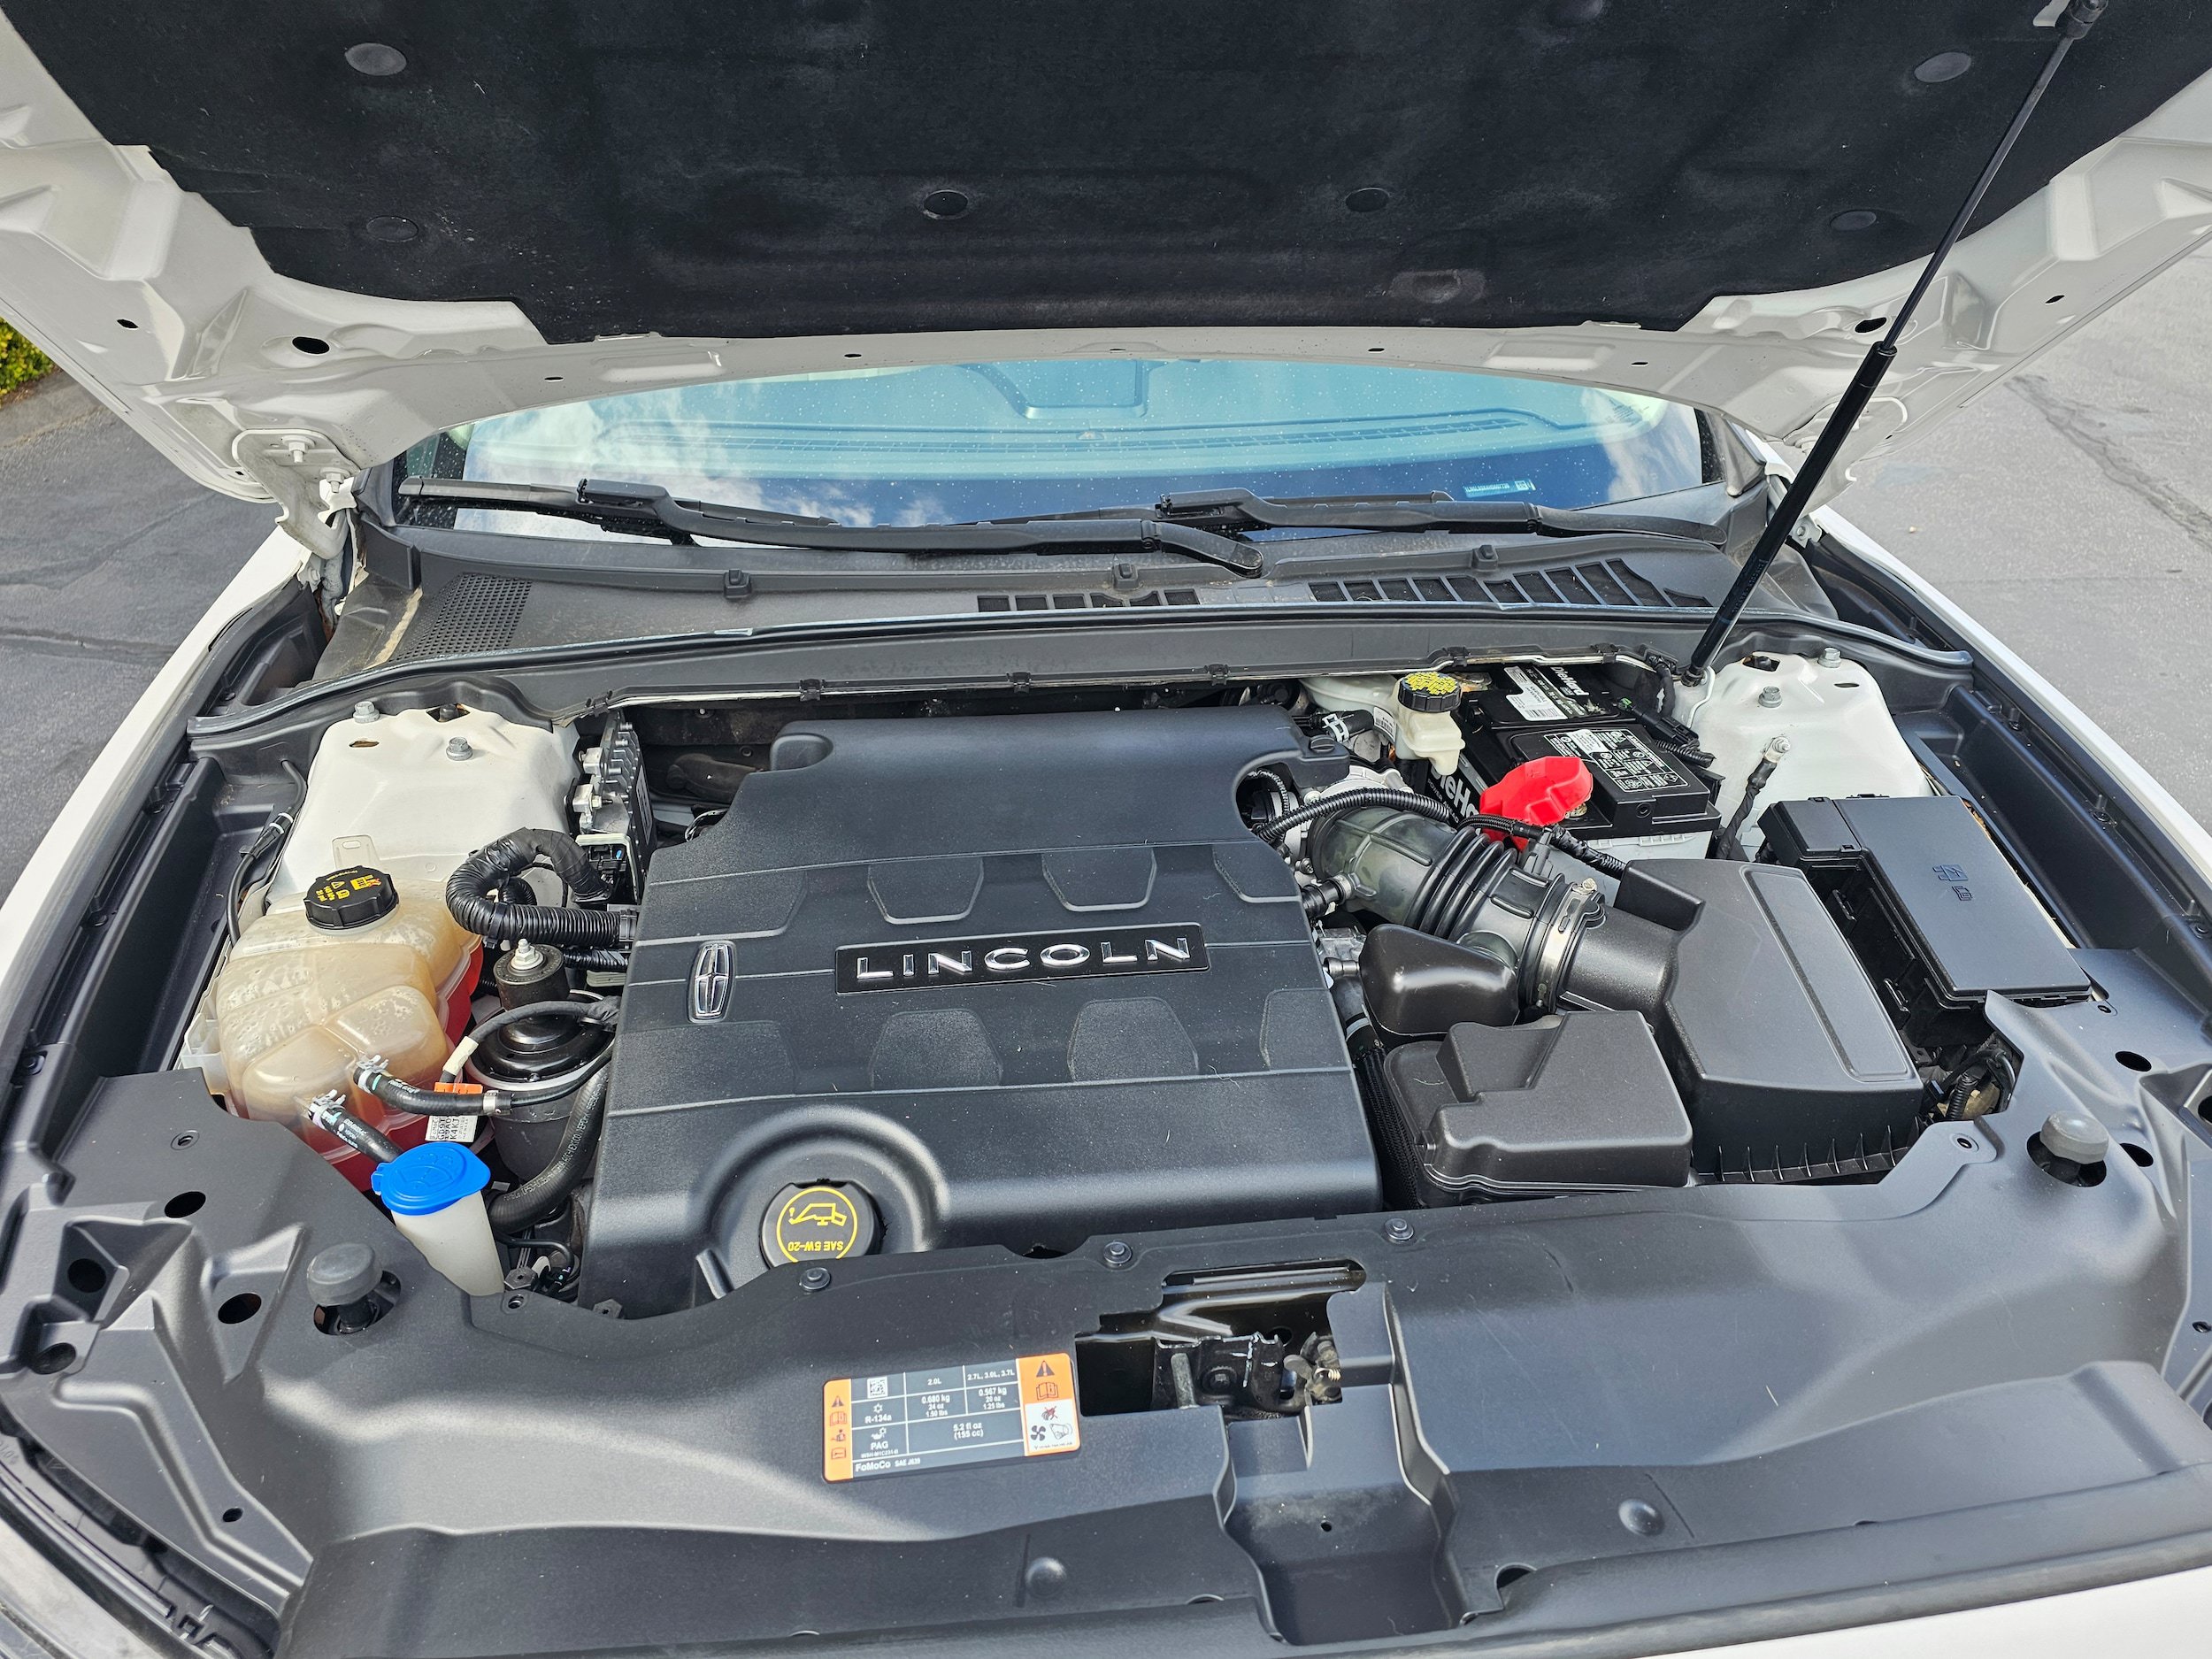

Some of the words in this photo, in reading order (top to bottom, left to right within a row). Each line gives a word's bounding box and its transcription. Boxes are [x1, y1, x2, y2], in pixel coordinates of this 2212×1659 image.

[1550, 666, 1590, 695] DieHard
[1427, 779, 1443, 802] POWER
[1443, 801, 1459, 824] AHEAD
[856, 938, 1191, 979] LINCOLN
[787, 1240, 821, 1251] 5W-20
[823, 1240, 844, 1251] SAE
[997, 1386, 1007, 1395] kg
[941, 1394, 950, 1402] kg
[864, 1413, 892, 1424] R-134a
[871, 1440, 888, 1450] PAG
[855, 1460, 891, 1472] FoMoCo
[895, 1458, 907, 1467] SAE
